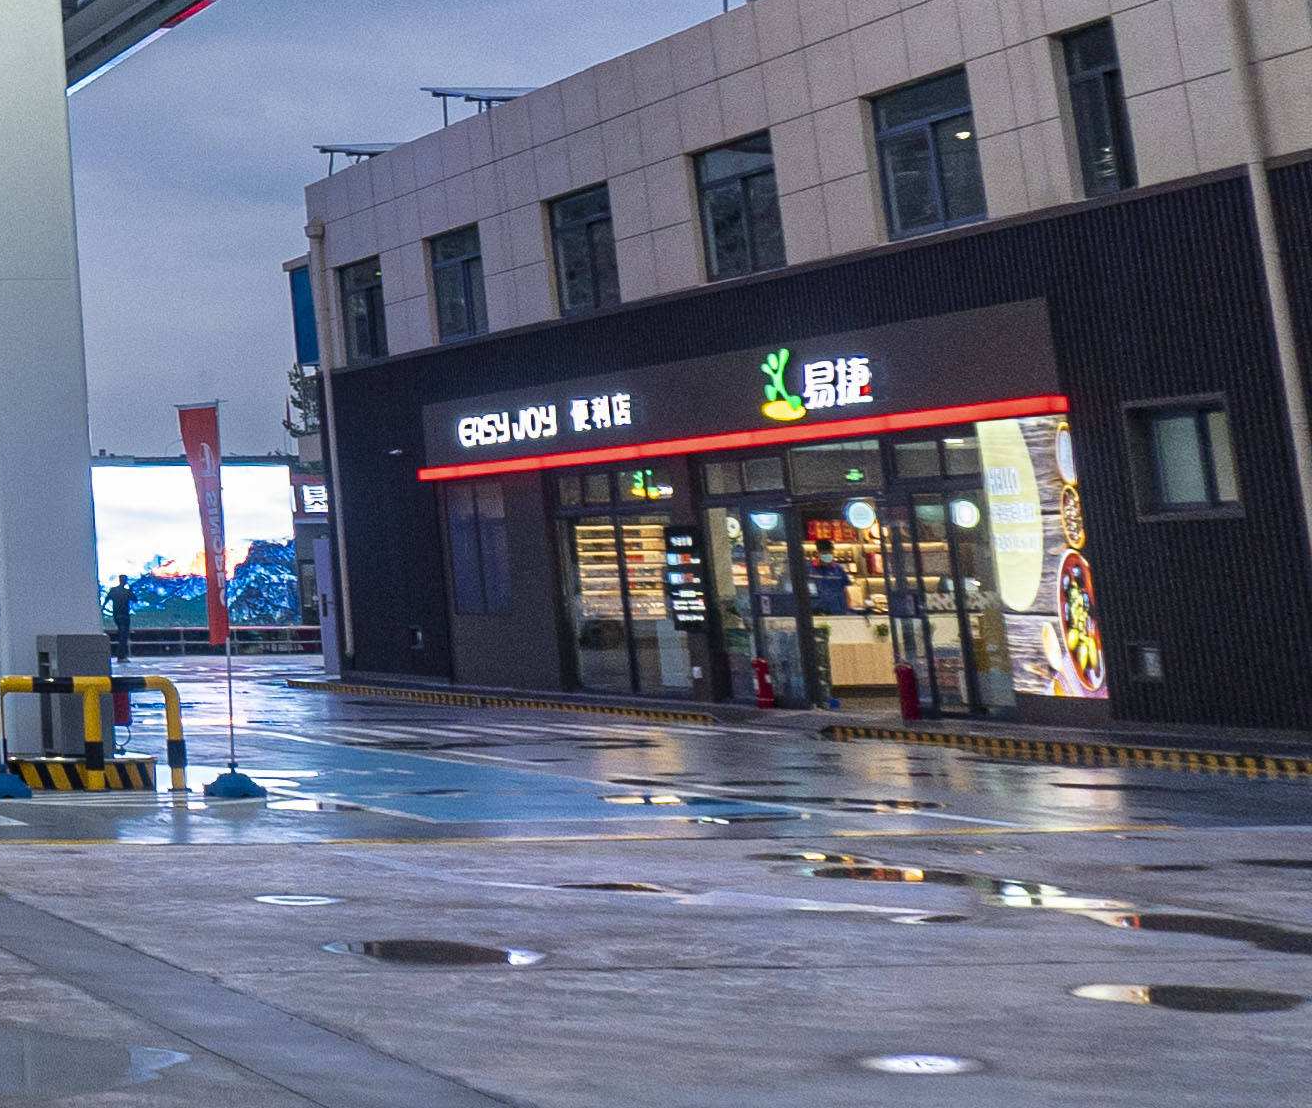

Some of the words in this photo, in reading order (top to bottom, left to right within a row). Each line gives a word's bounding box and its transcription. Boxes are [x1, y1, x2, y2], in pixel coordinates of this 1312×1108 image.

[802, 356, 873, 410] 易捷
[457, 411, 511, 449] EASY
[511, 403, 558, 441] JOY
[570, 392, 632, 432] 便利店
